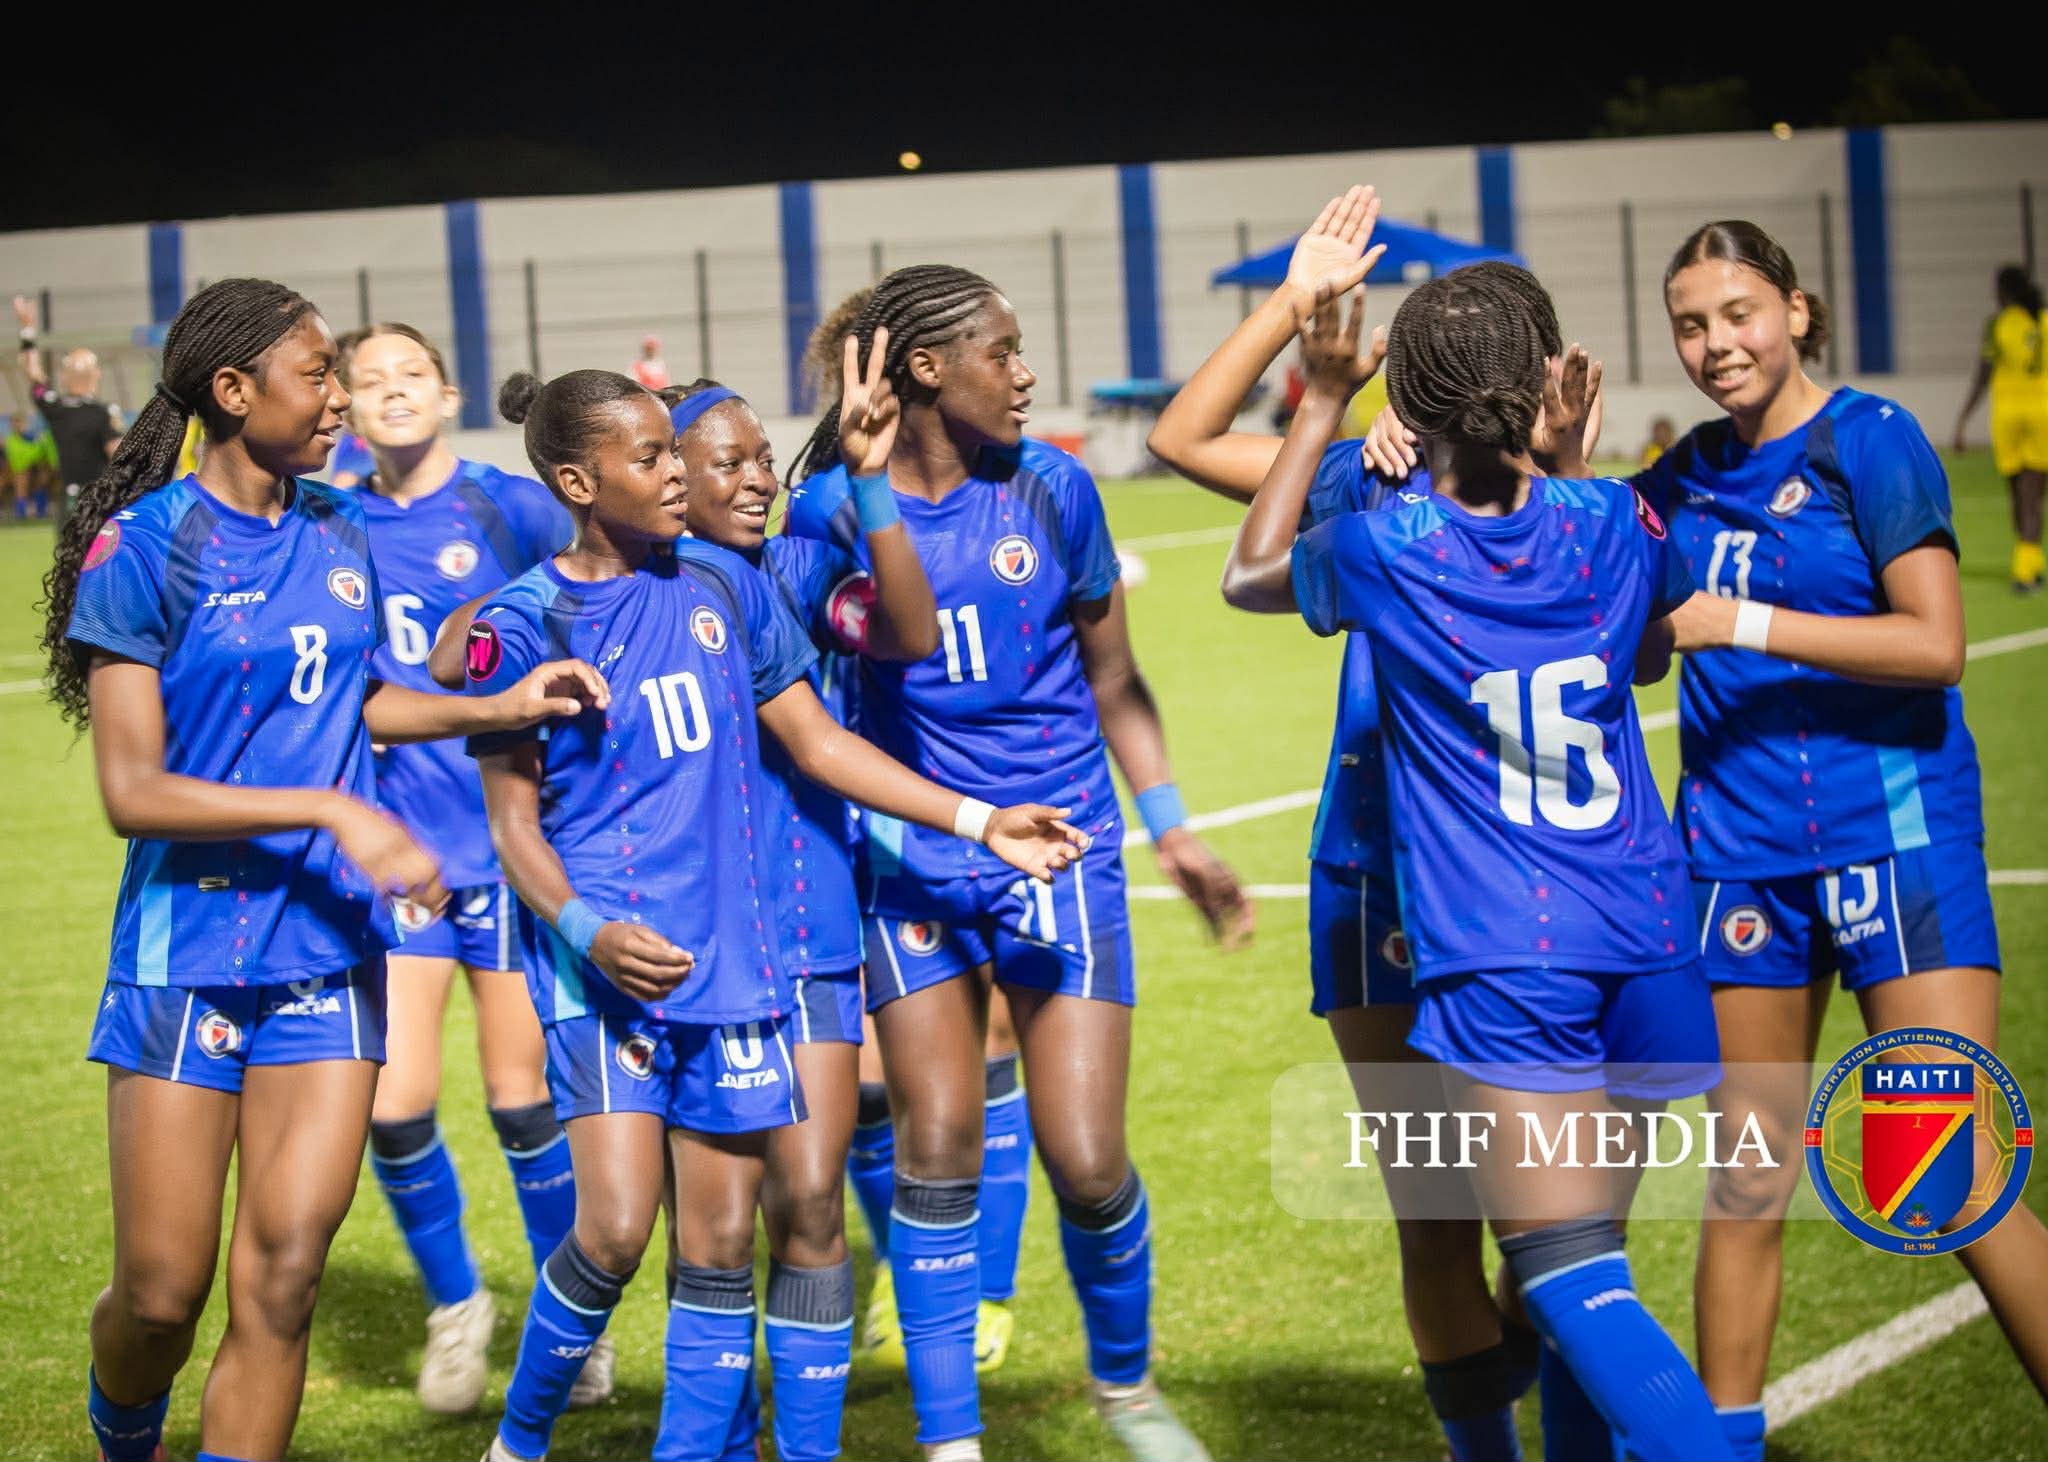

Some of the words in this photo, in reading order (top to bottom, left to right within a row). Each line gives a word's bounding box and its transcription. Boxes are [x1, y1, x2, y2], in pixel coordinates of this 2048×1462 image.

[202, 590, 267, 608] SAETA
[1706, 530, 1758, 601] 13
[289, 624, 328, 705] 8
[385, 593, 429, 666] 6
[936, 604, 988, 683] 11
[639, 671, 712, 760] 10
[1470, 654, 1622, 831] 16
[715, 1068, 780, 1090] SAETA
